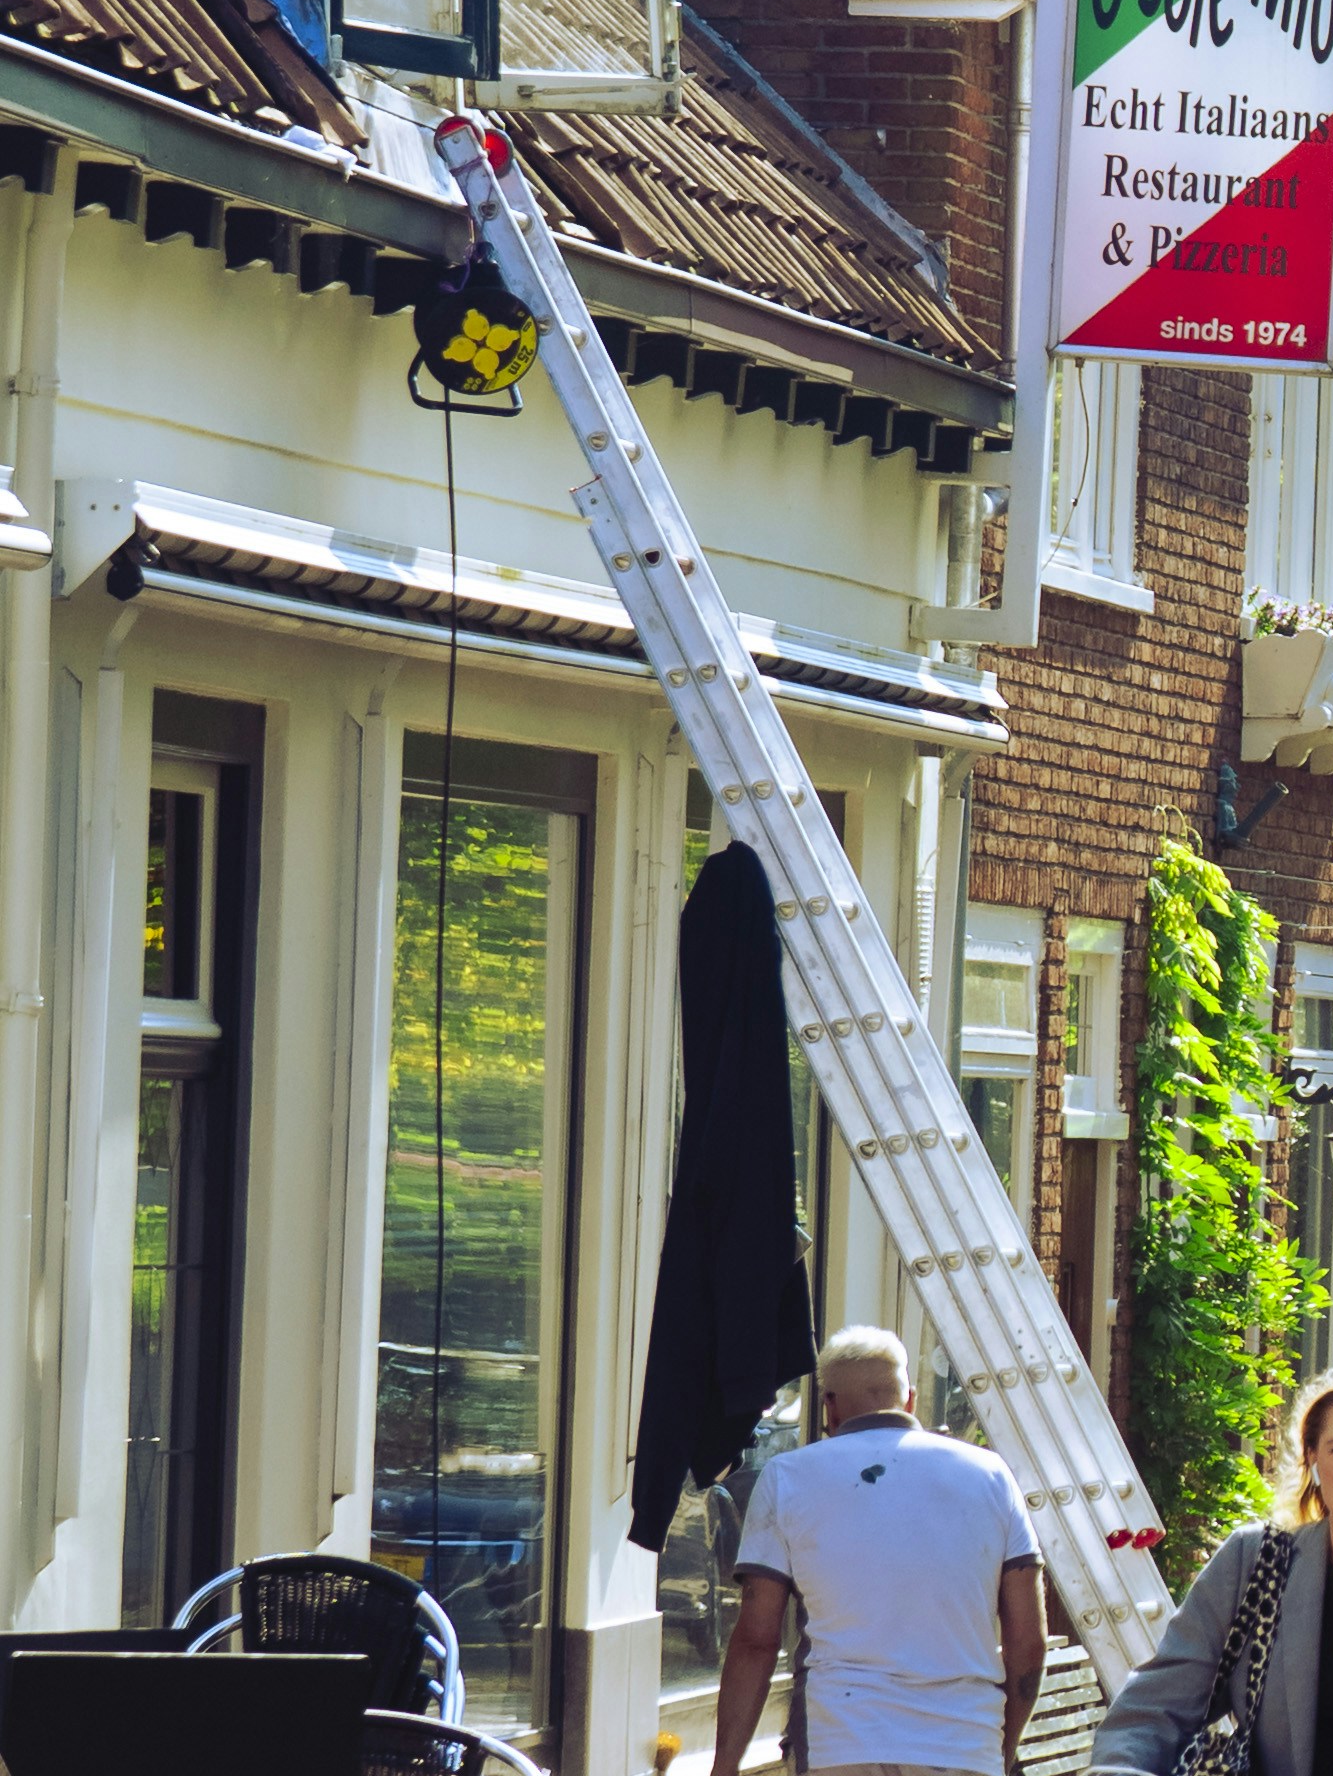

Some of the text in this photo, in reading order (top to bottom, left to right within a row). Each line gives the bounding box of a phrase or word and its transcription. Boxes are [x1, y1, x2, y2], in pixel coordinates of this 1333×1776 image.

[1082, 85, 1329, 146] Echt Italiaans
[1101, 154, 1300, 210] Restaurant
[1102, 223, 1288, 277] & Pizzeria
[1160, 316, 1307, 347] sinds 1974
